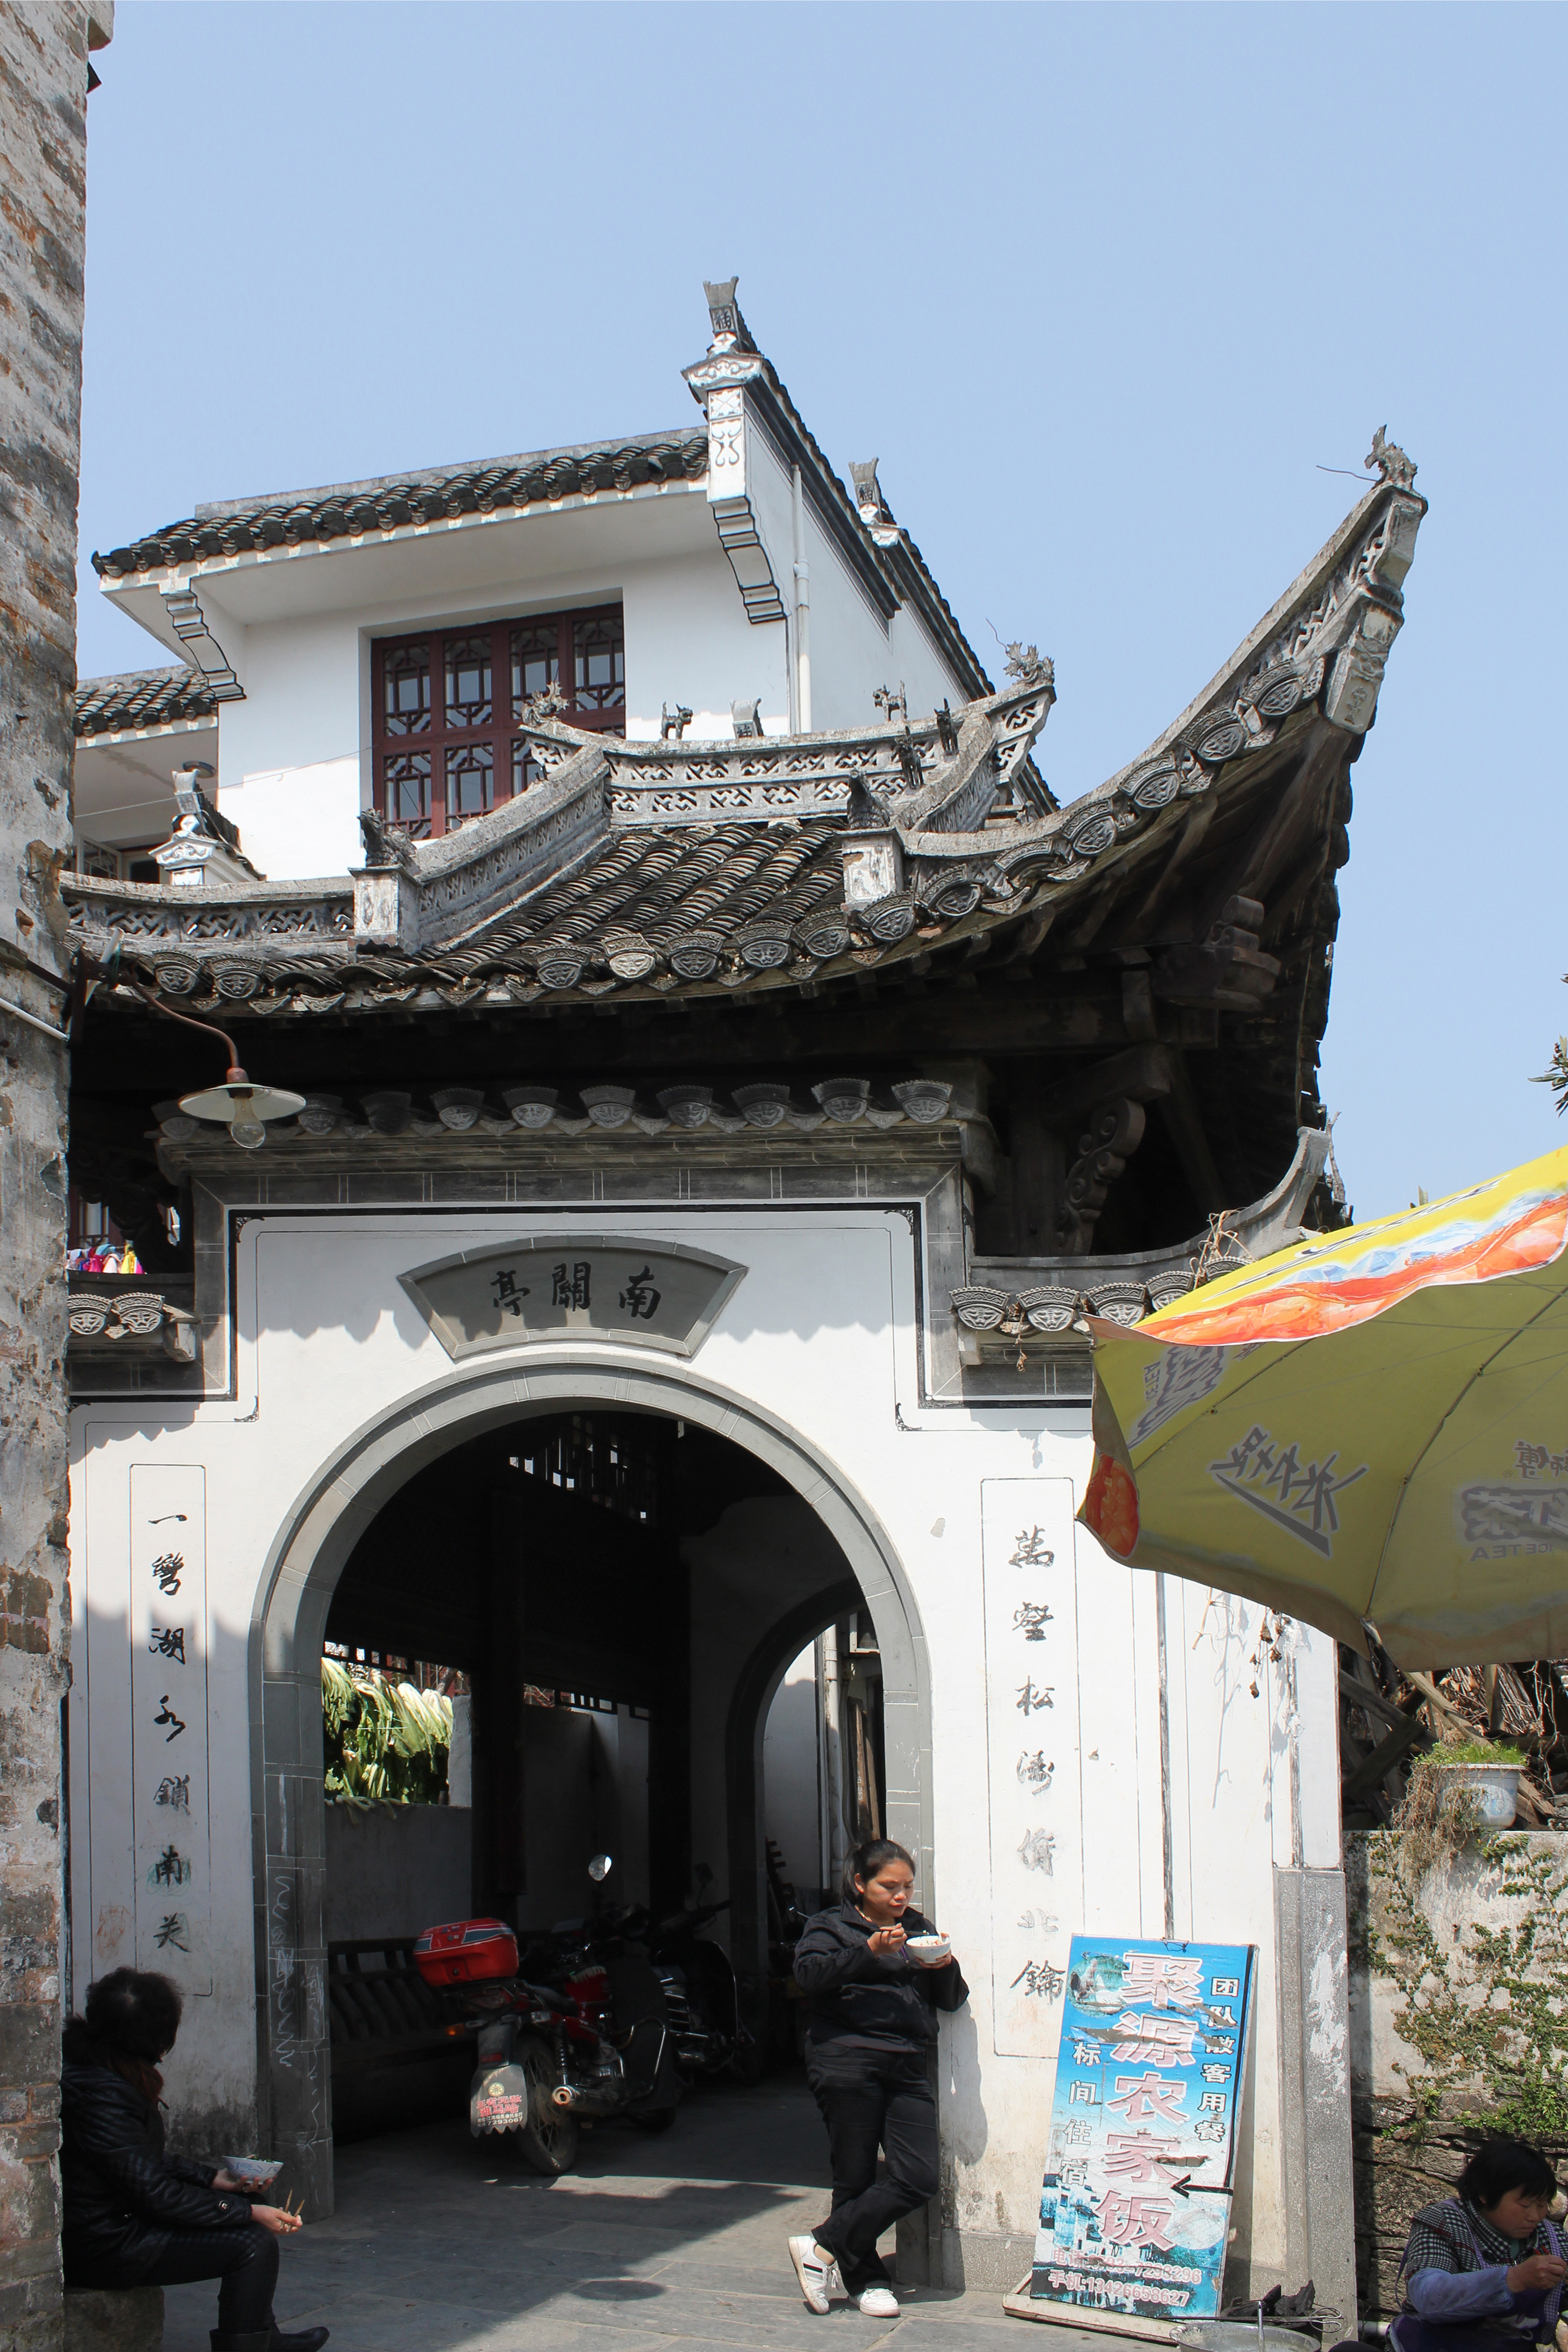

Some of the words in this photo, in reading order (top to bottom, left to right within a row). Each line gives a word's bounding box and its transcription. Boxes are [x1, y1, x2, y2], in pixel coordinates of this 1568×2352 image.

[479, 2103, 519, 2118] 雅马哈
[1059, 2041, 1102, 2188] 标间住宿
[1096, 1953, 1204, 2251] 聚源农家饭
[1194, 1976, 1240, 2143] 团队散客用餐
[1048, 2269, 1190, 2307] 手机:13426658627
